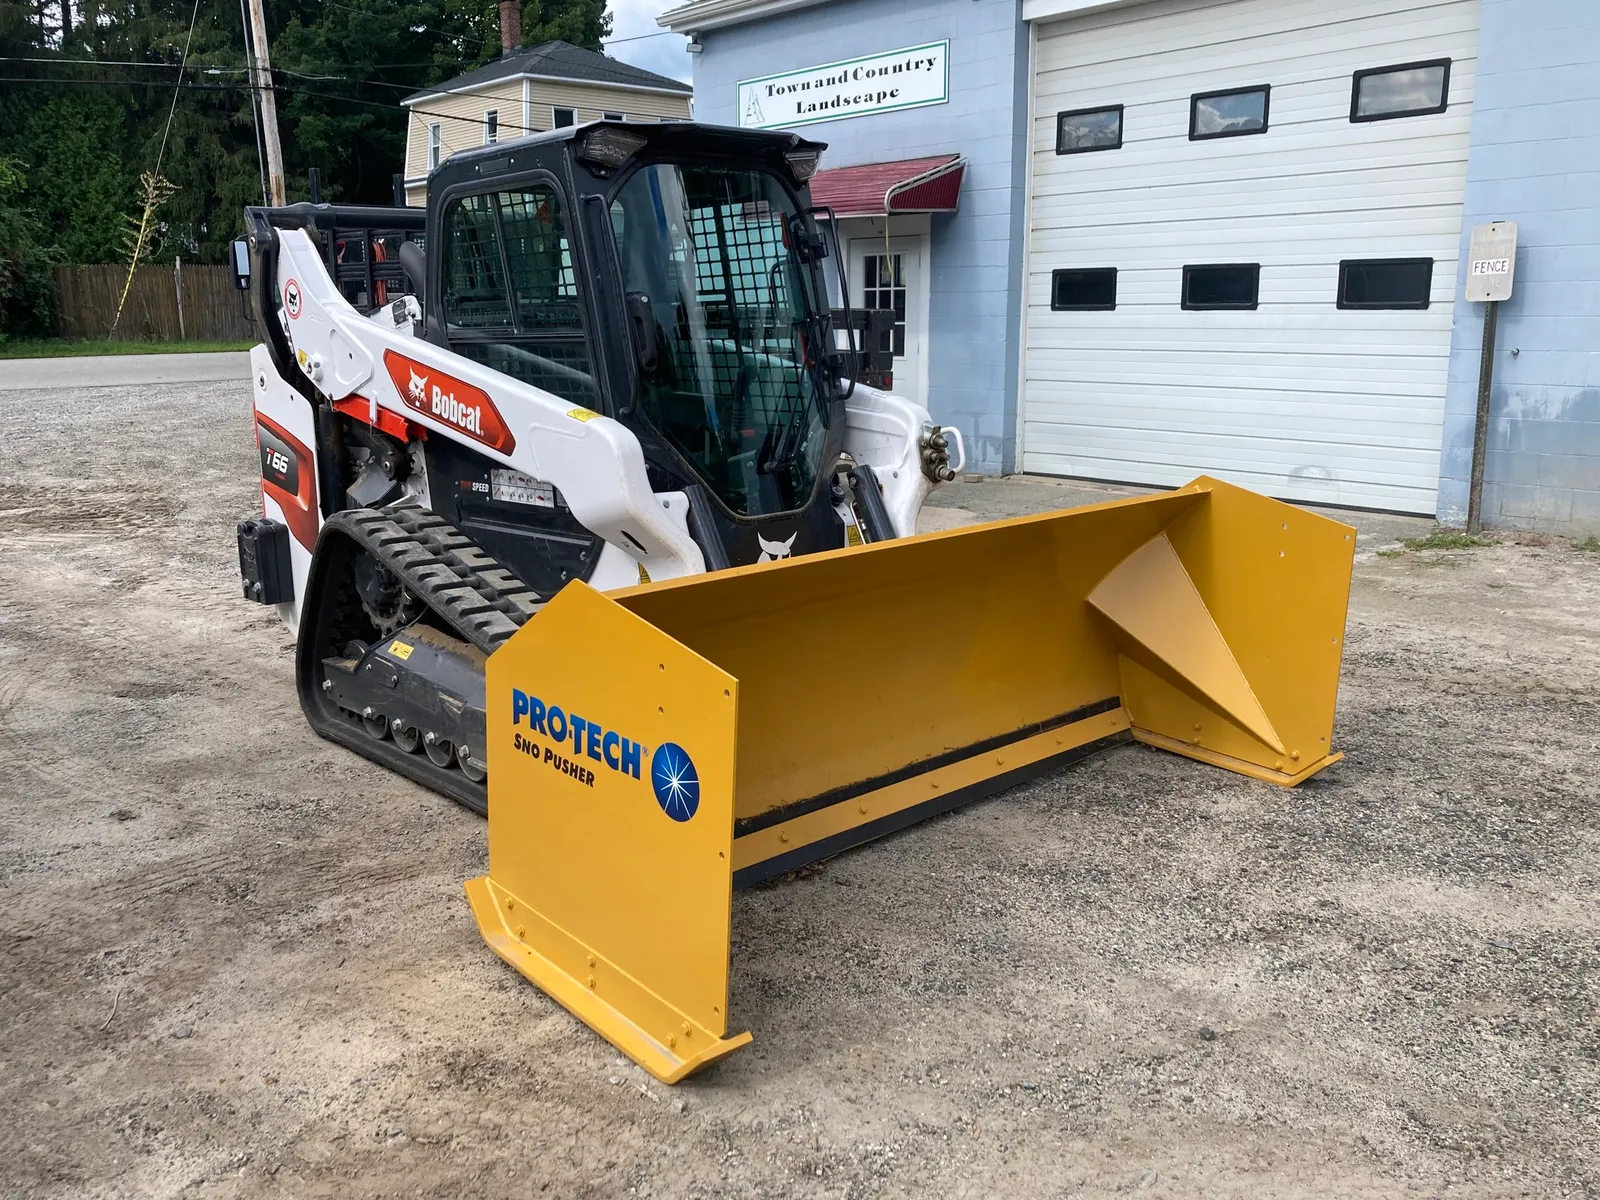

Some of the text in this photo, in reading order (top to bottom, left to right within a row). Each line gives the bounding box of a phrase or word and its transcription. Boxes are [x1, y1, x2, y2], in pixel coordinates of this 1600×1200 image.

[765, 57, 937, 97] Town and Country
[796, 87, 900, 114] Landscape
[1474, 260, 1507, 274] FENCE
[266, 447, 289, 474] T66
[471, 482, 490, 493] SPEED
[513, 732, 596, 788] SNO PUSHER
